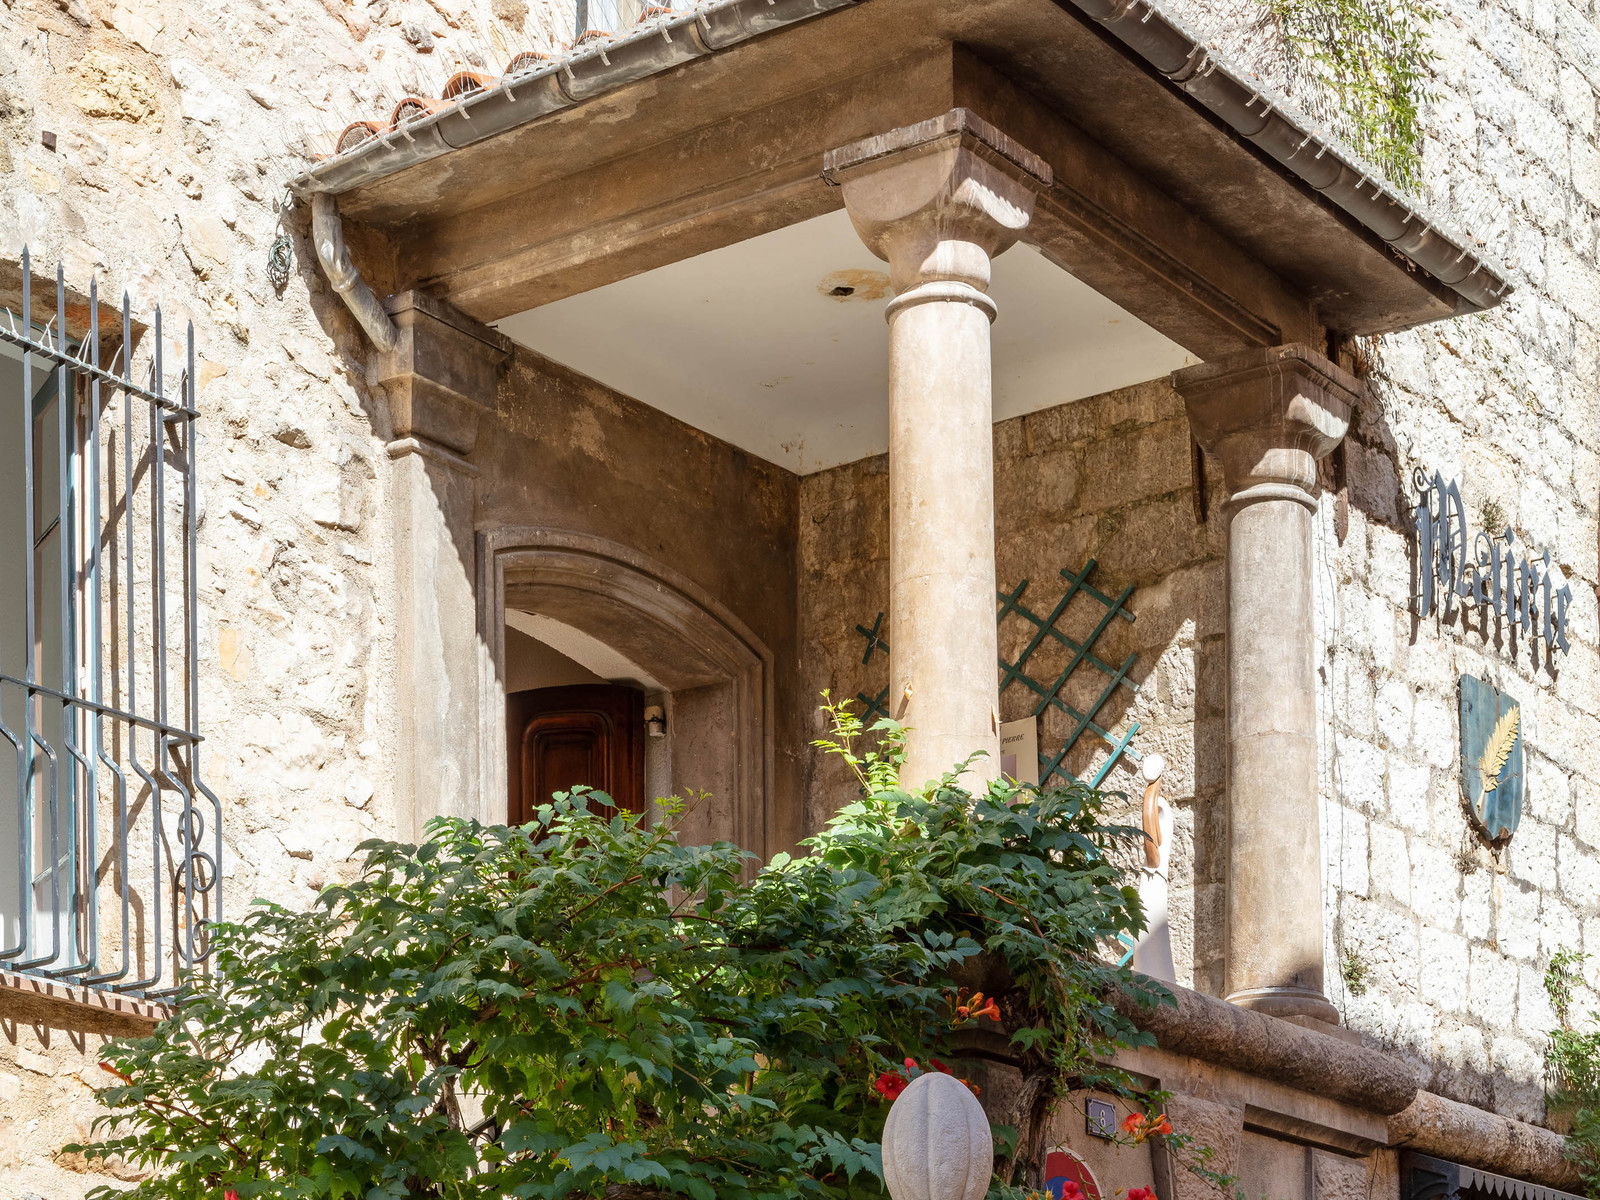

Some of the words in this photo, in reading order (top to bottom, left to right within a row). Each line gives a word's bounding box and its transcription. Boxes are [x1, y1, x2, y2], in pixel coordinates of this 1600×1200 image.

[1413, 466, 1573, 657] Mairie
[1002, 734, 1025, 744] PIERRE
[1100, 1110, 1106, 1128] 6
